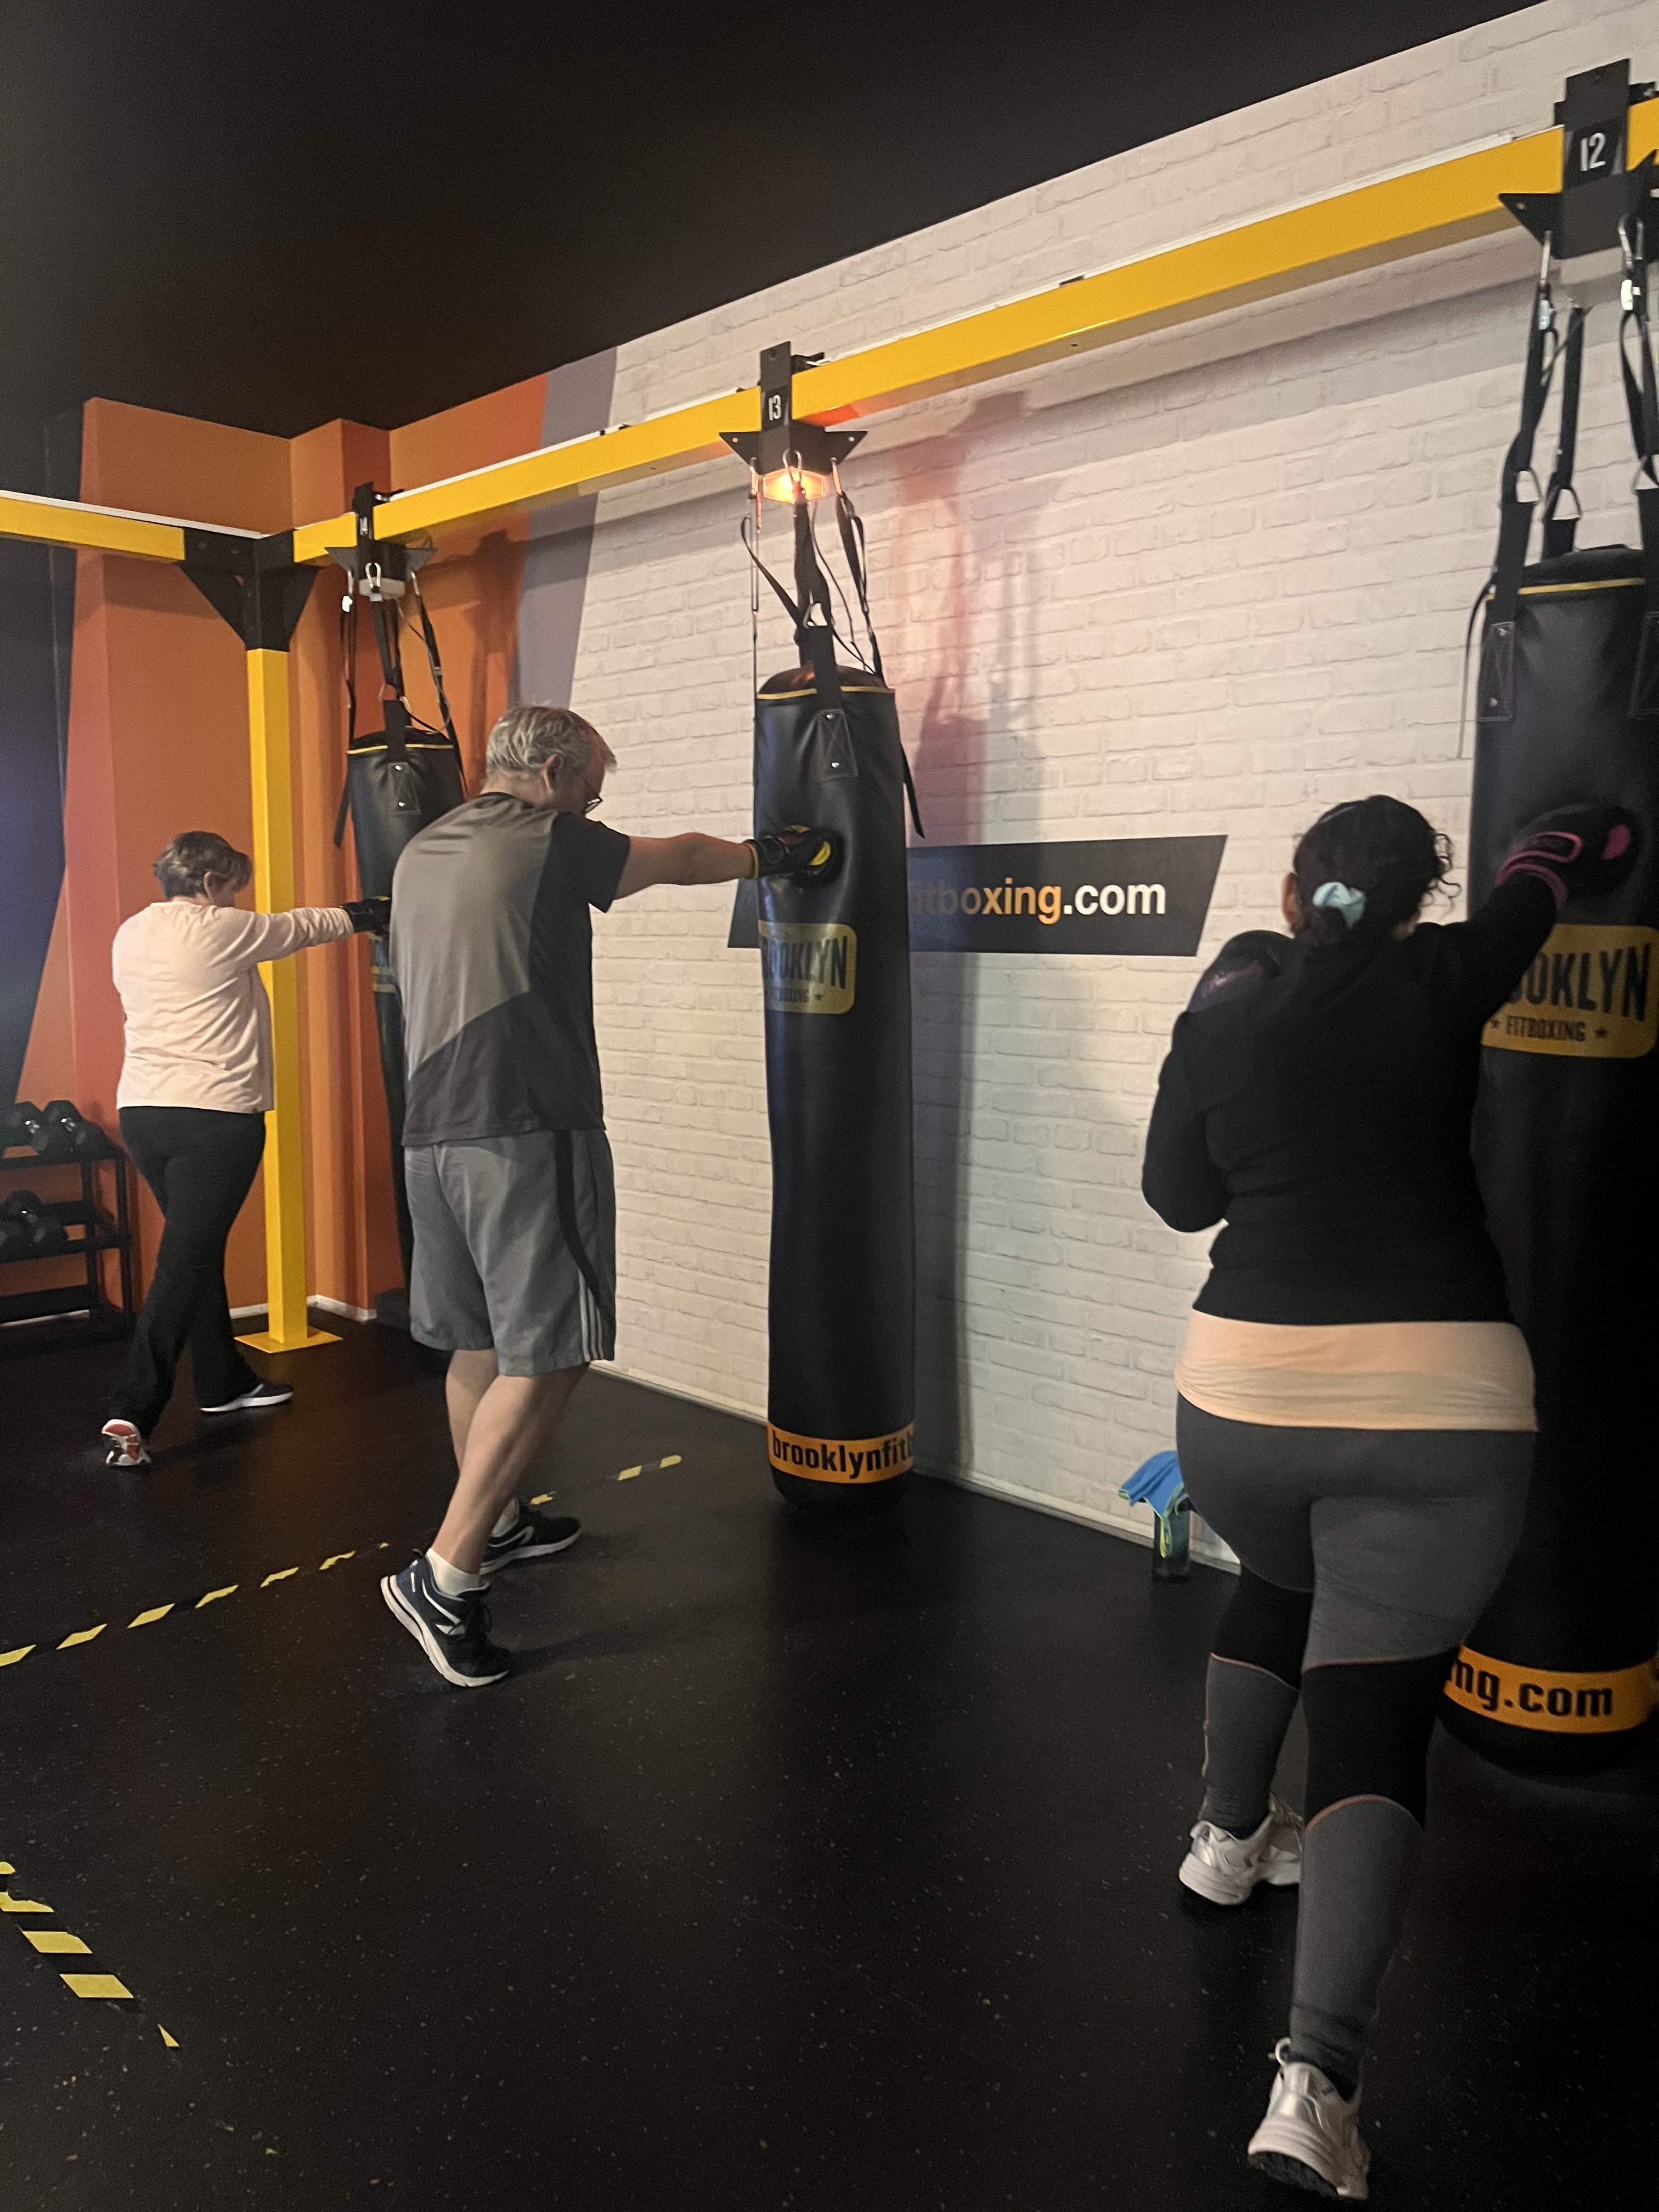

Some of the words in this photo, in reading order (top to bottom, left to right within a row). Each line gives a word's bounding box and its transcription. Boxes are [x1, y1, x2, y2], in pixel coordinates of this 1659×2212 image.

[1580, 132, 1606, 171] 12
[768, 394, 781, 421] 13
[1509, 943, 1651, 1022] OKLYN
